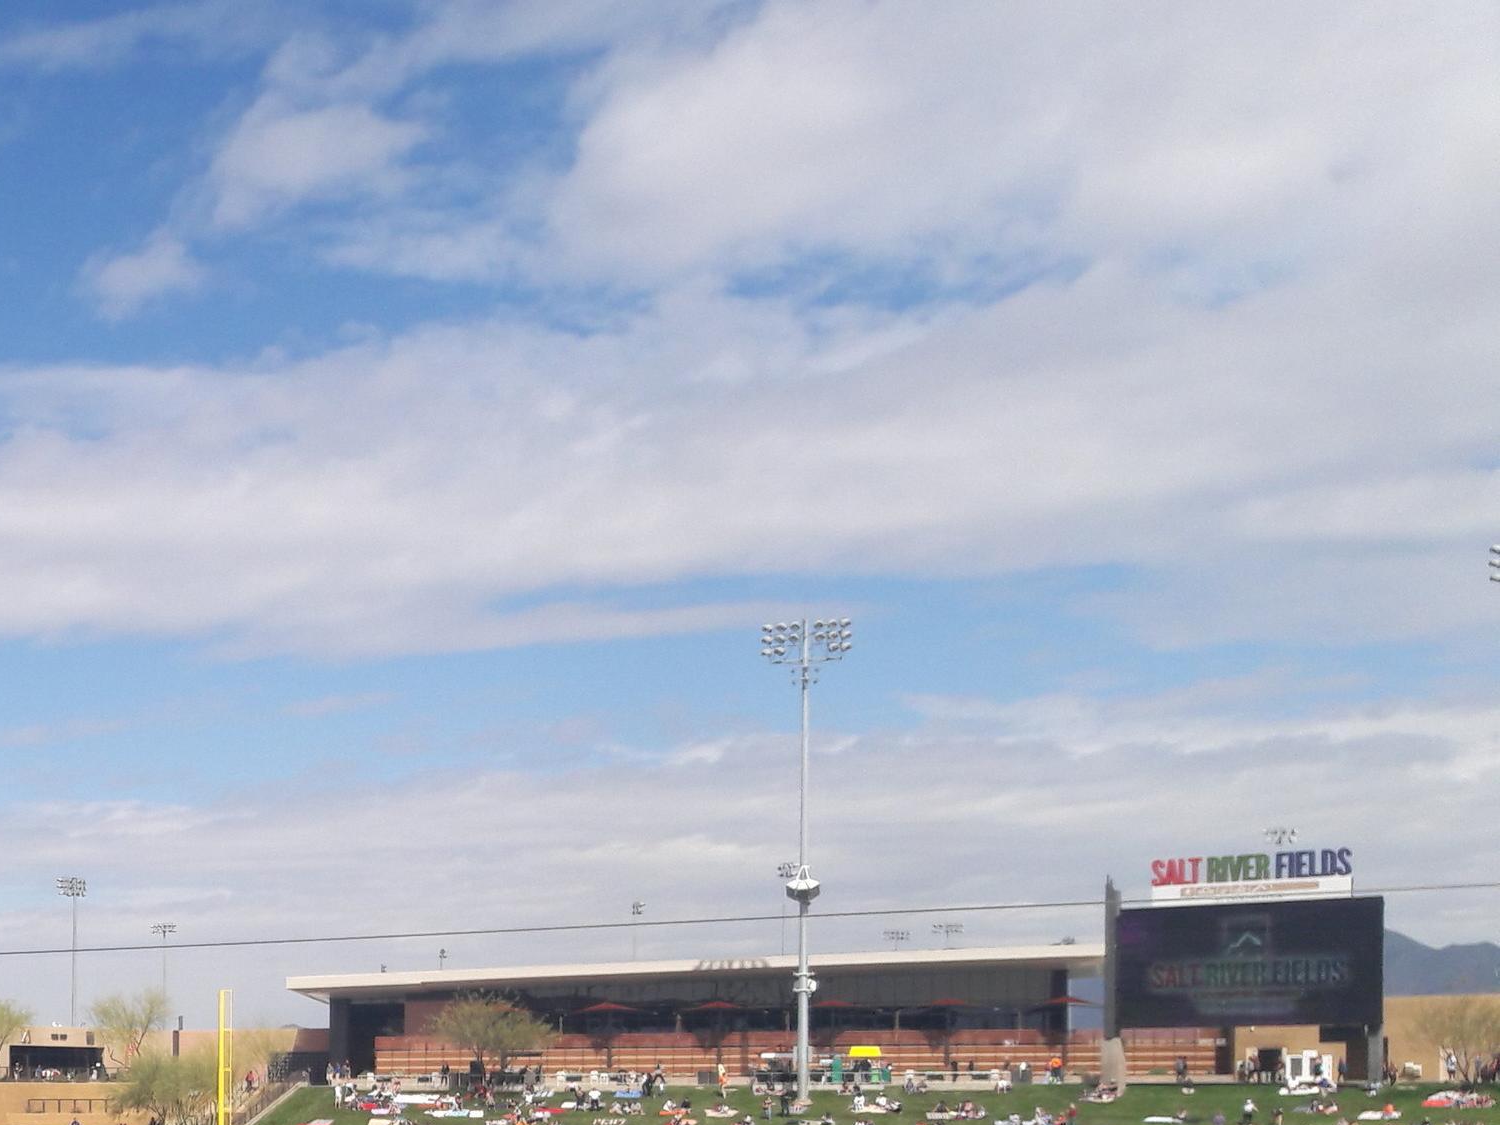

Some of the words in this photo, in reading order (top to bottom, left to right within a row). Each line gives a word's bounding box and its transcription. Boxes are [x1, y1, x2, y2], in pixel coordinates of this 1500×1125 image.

[1151, 857, 1203, 886] SALT
[1206, 853, 1270, 882] RIVER
[1275, 848, 1352, 878] FIELDS
[1150, 960, 1203, 987] SALT
[1204, 960, 1269, 986] RIVER
[1273, 959, 1345, 984] FIELDS
